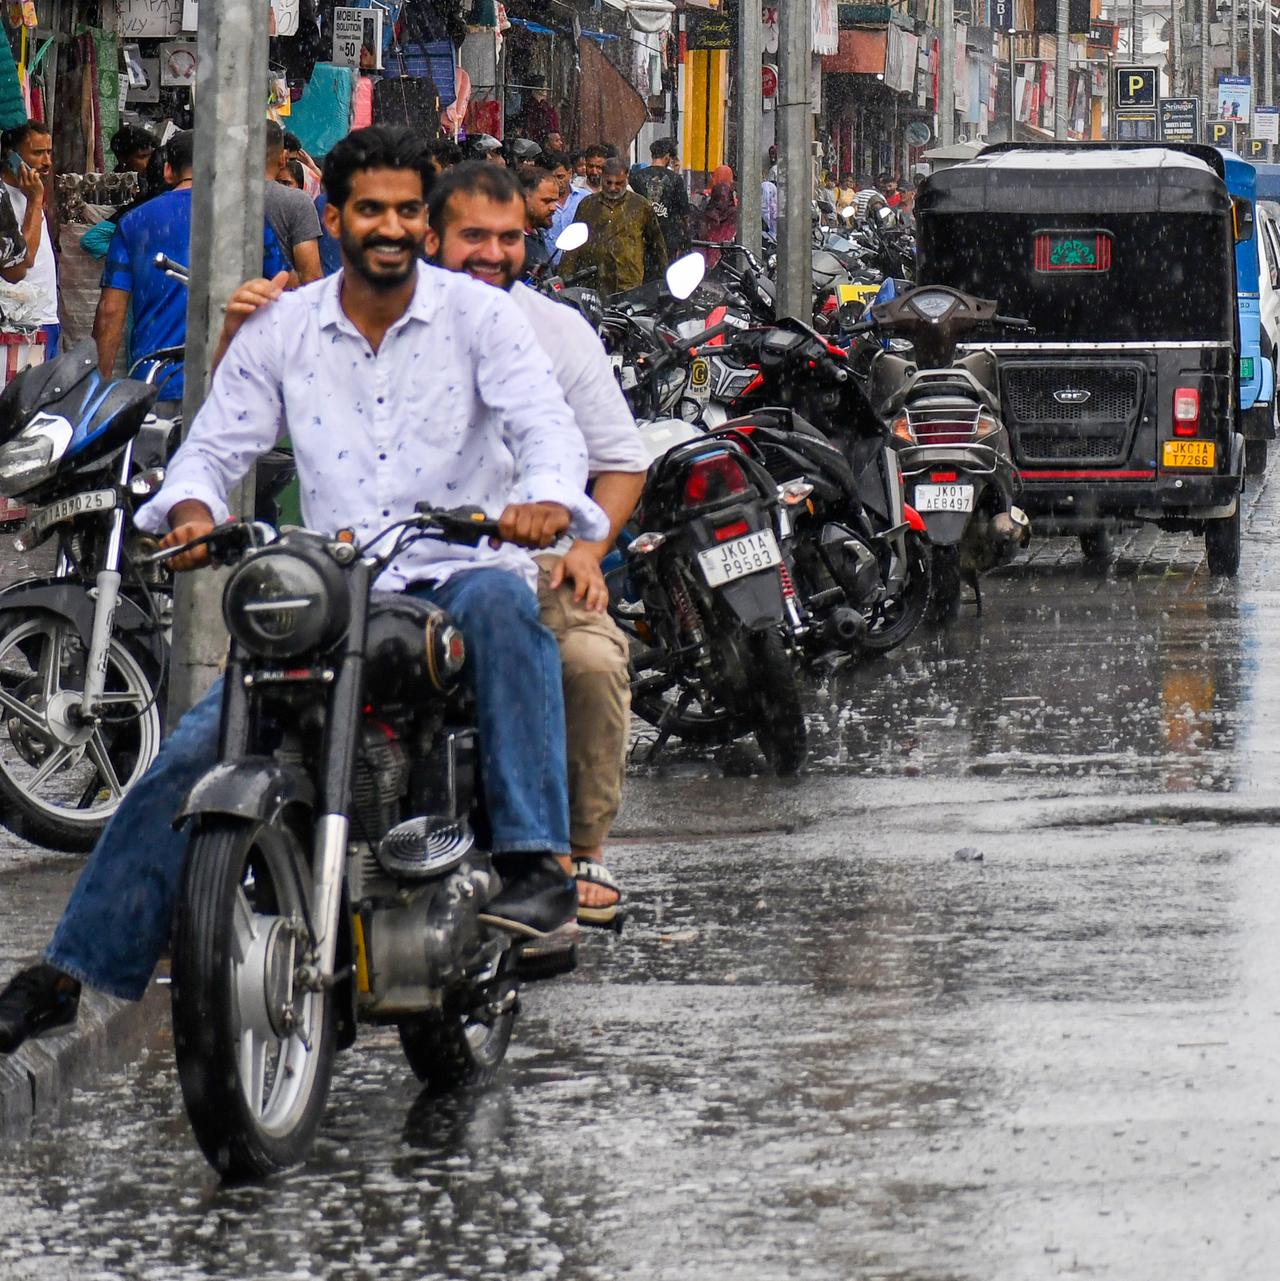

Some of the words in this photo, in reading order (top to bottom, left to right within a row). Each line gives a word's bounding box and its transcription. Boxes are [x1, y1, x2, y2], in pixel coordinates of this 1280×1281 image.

[336, 10, 361, 22] MOBILE
[336, 22, 361, 32] SOLUTION
[344, 42, 356, 57] 50
[1128, 75, 1144, 96] P
[1213, 124, 1227, 142] P
[1251, 141, 1262, 155] P
[1172, 454, 1208, 466] T7266
[935, 486, 963, 497] JK01
[926, 497, 970, 510] AE8497
[720, 535, 767, 562] JK01A
[723, 550, 772, 579] P9583
